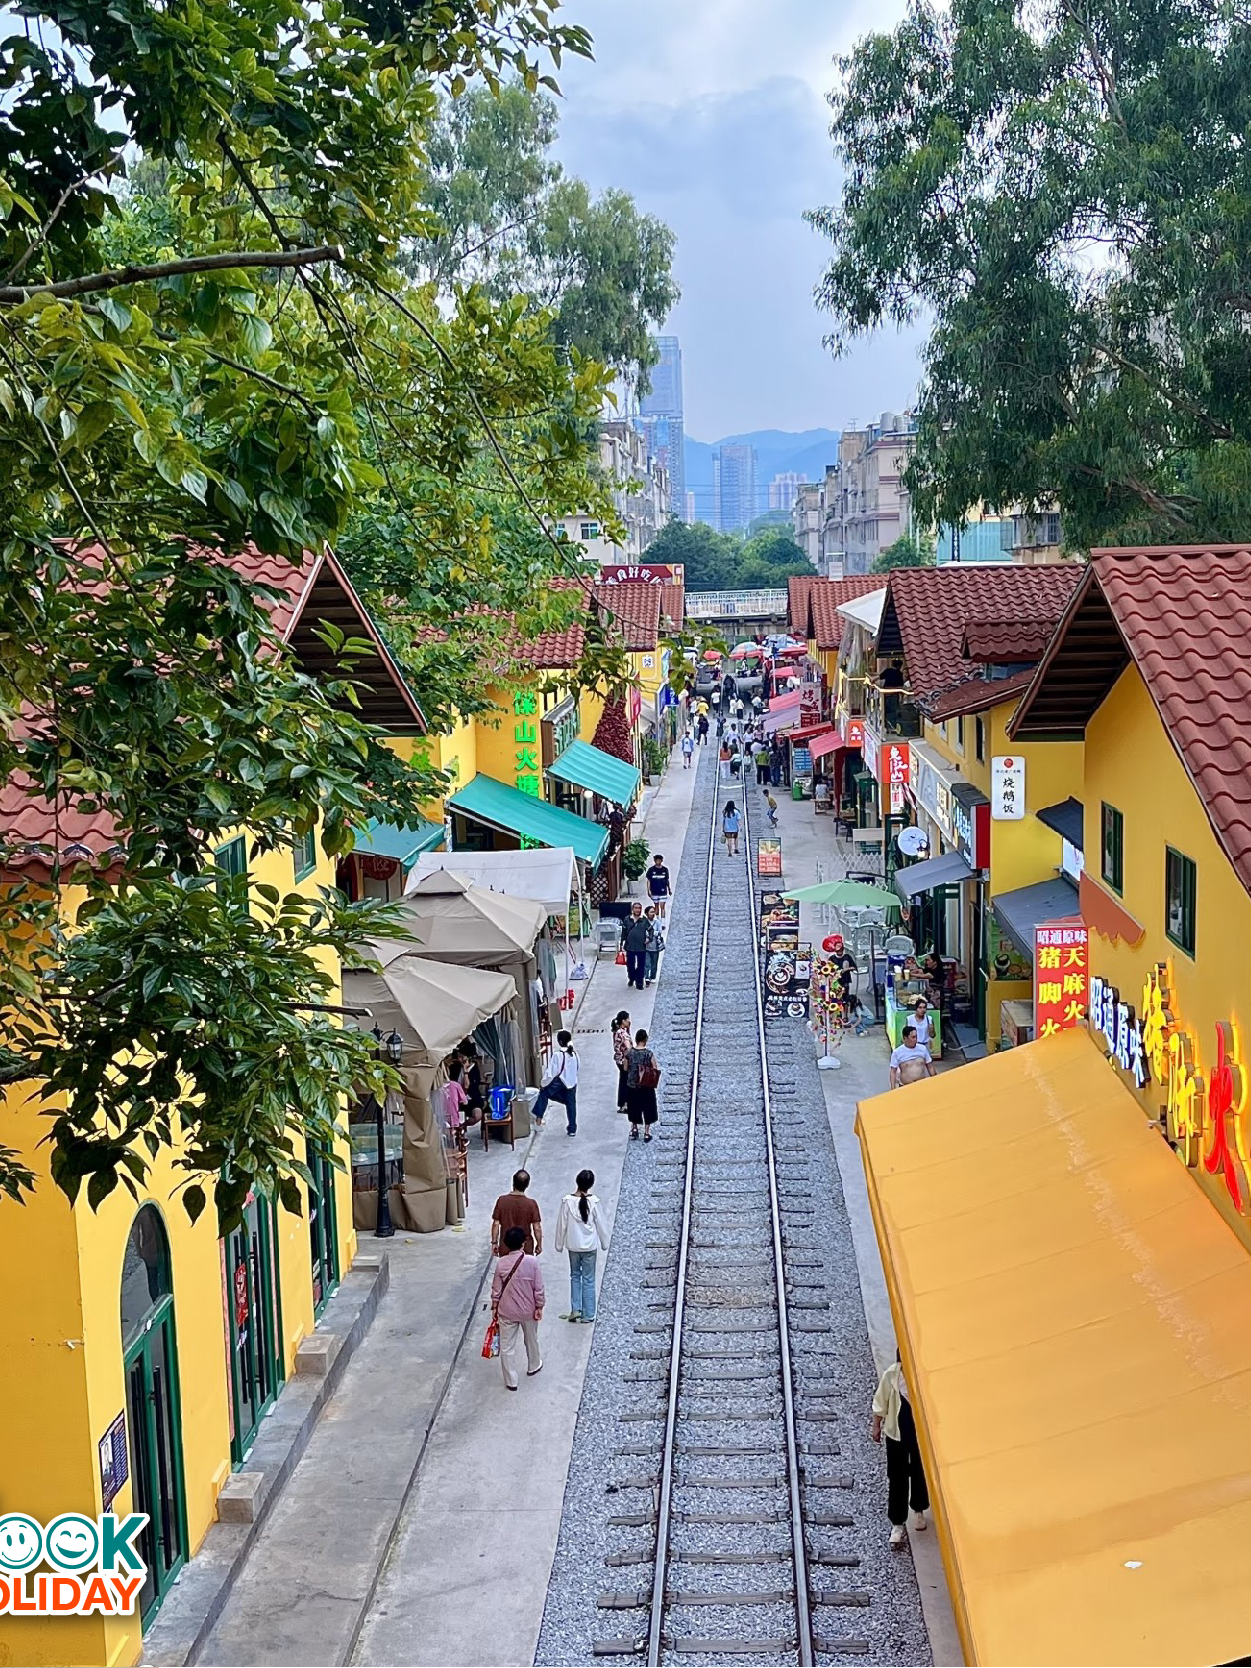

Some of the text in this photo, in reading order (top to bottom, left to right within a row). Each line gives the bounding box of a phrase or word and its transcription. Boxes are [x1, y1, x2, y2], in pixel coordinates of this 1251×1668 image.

[1037, 929, 1088, 944] 昭通原味
[1063, 946, 1086, 1030] 天麻火
[1090, 976, 1145, 1088] 昭通原味
